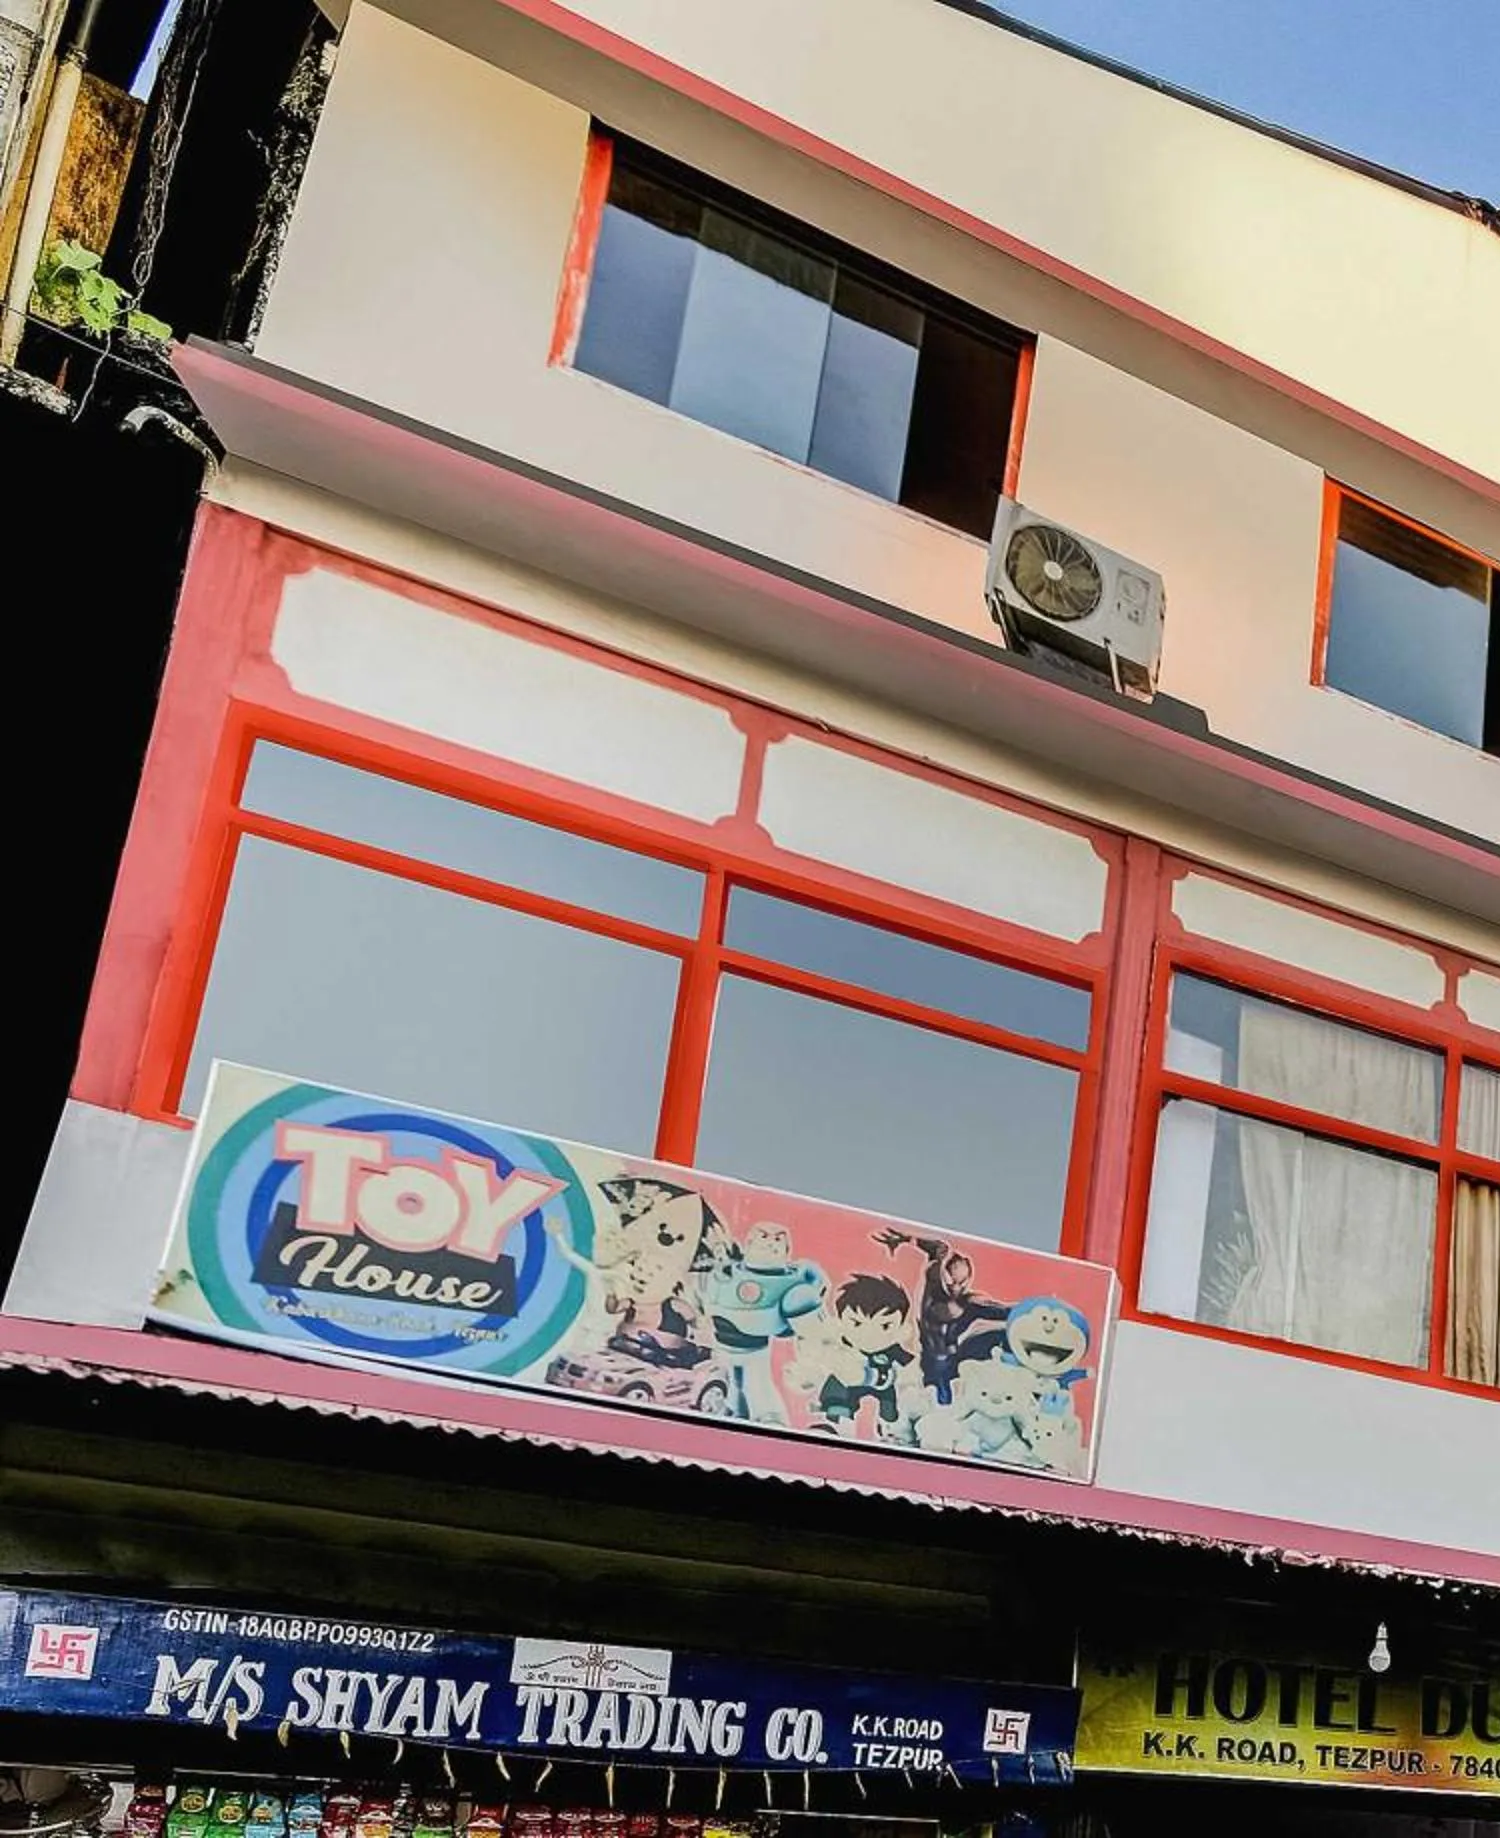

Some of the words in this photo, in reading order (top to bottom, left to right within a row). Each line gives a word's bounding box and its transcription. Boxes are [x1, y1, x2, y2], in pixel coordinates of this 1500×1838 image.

[276, 1121, 566, 1262] TOY
[279, 1235, 503, 1308] House
[144, 1655, 266, 1725] M/S
[284, 1666, 491, 1740] SHYAM
[515, 1684, 747, 1757] TRADING
[765, 1706, 828, 1764] CO.
[1154, 1653, 1398, 1737] HOTEL
[852, 1742, 944, 1771] TEZPUR
[1141, 1730, 1206, 1759] K.K.
[1216, 1736, 1306, 1772] ROAD,
[1315, 1744, 1424, 1774] TEZPUR
